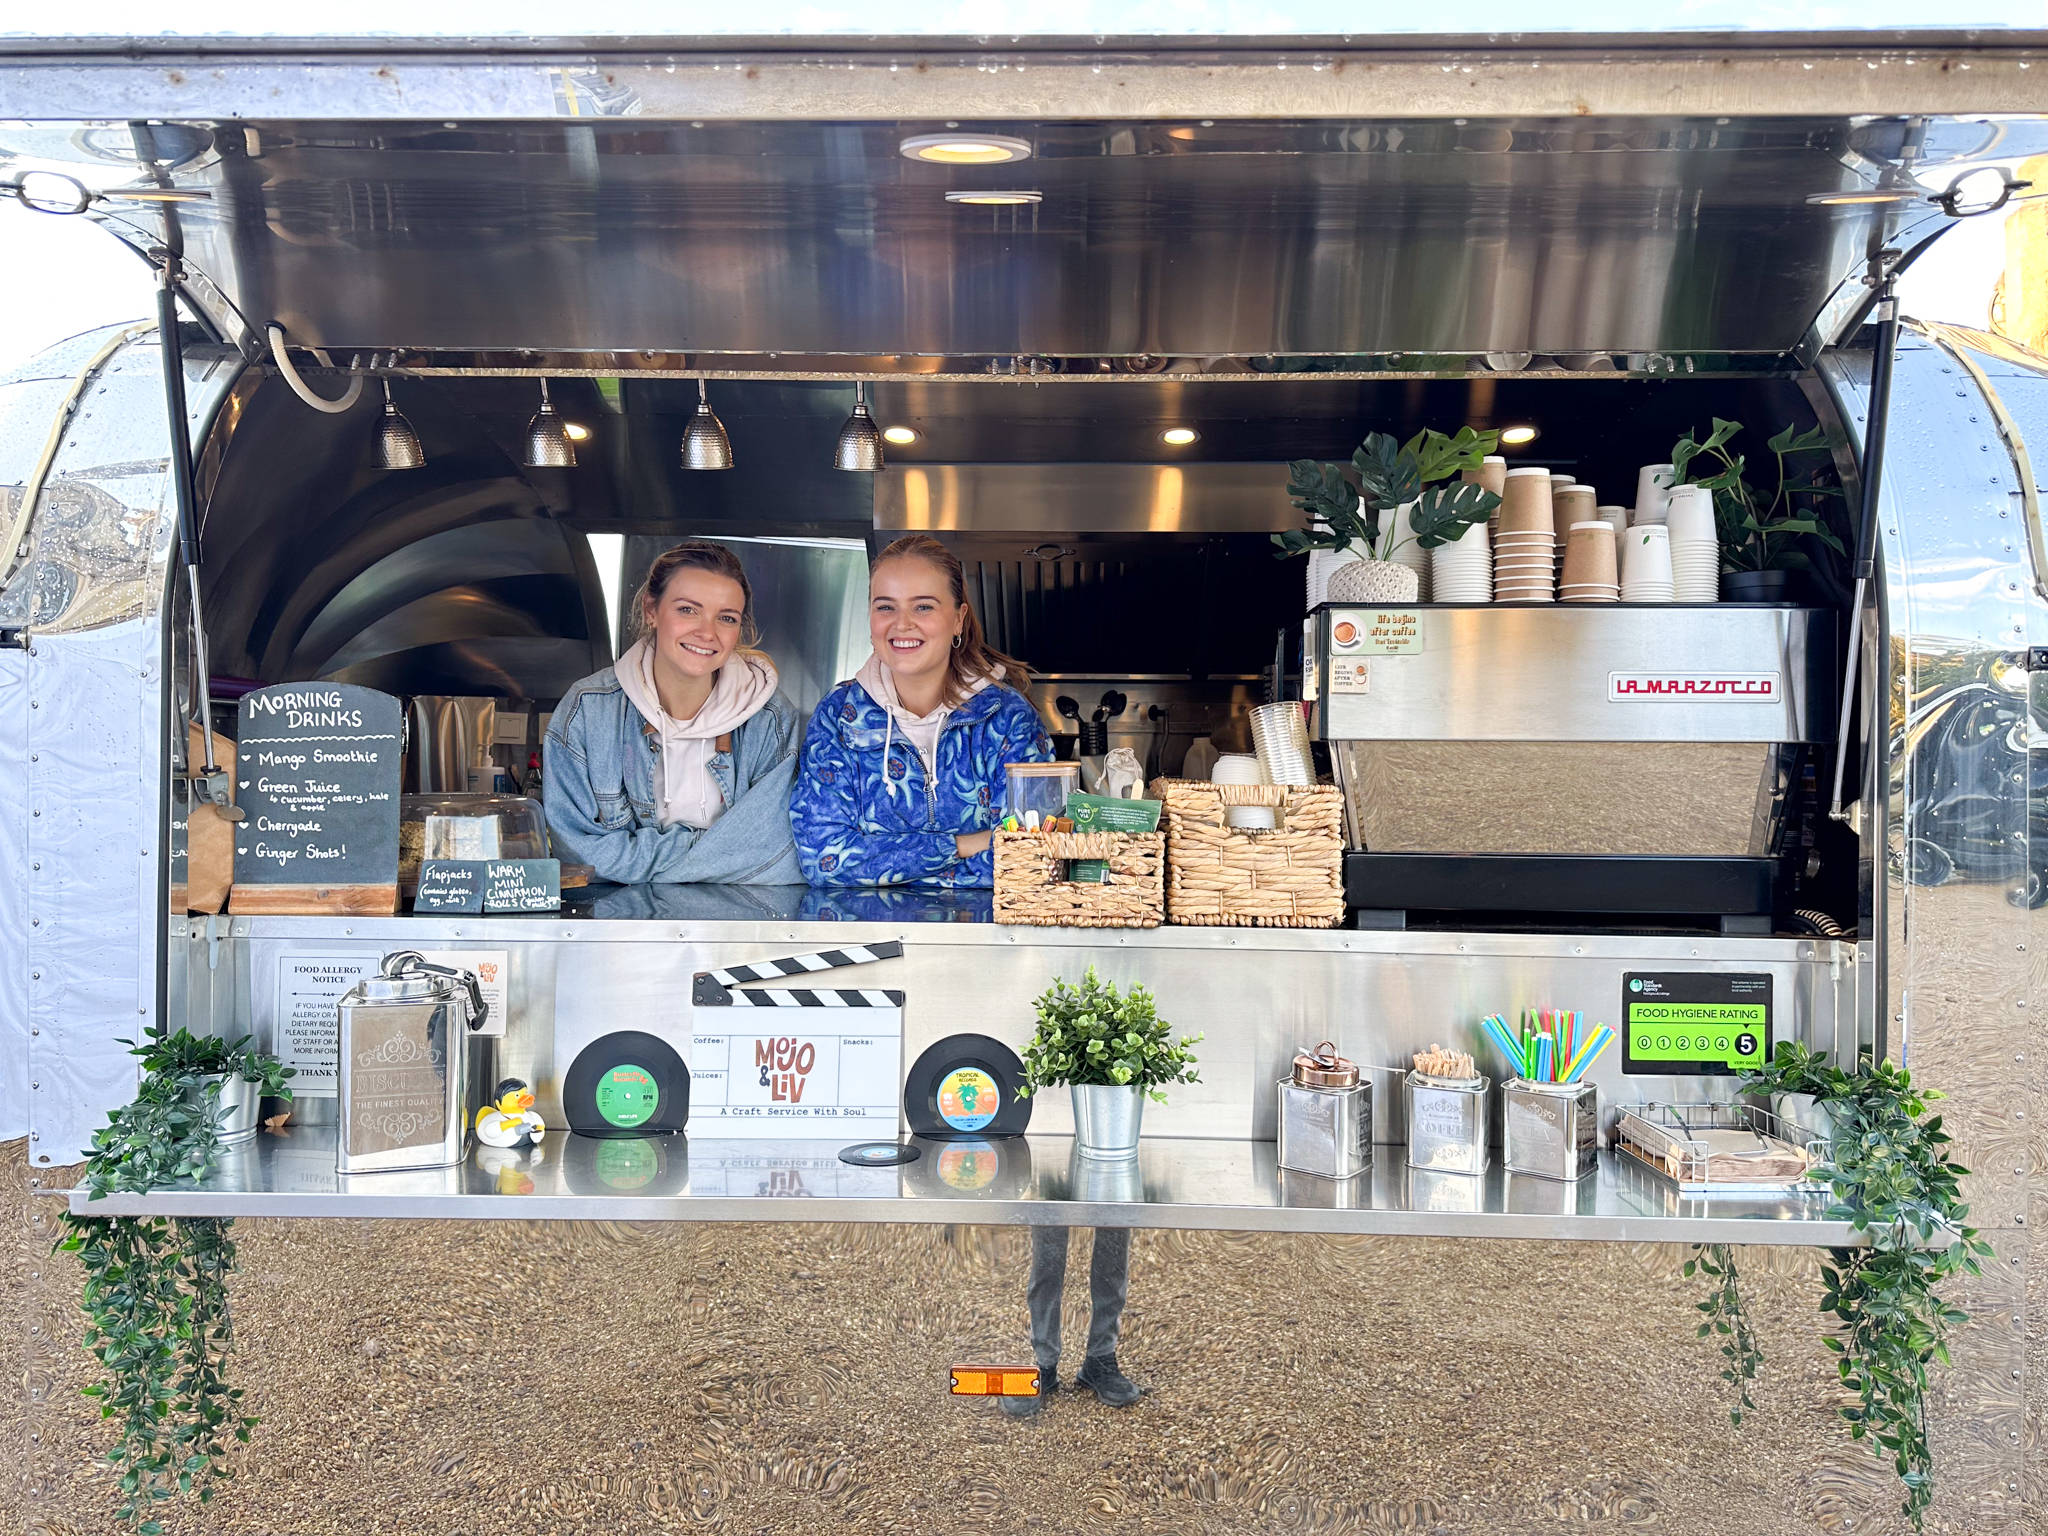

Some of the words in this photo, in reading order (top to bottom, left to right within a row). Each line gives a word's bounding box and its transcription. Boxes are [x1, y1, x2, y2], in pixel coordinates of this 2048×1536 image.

[1392, 614, 1416, 625] begins
[1370, 627, 1389, 636] after
[1392, 627, 1416, 636] coffee
[1617, 680, 1637, 694] LA
[250, 691, 342, 719] MORNING
[286, 710, 362, 729] DRINKS
[259, 752, 306, 770] Mango
[313, 749, 378, 763] Smoothie
[258, 777, 298, 793] Green
[305, 780, 341, 792] Juice
[258, 816, 322, 838] Cherryade
[256, 842, 298, 866] Ginger
[306, 844, 346, 859] Shots!
[426, 865, 472, 884] Flapjacks
[488, 864, 526, 878] WARM
[494, 876, 524, 890] MINI
[487, 885, 546, 899] CINNAMON
[321, 966, 362, 974] ALLERGY
[1637, 1009, 1669, 1018] FOOD
[1672, 1009, 1717, 1018] HYGIENE
[1720, 1010, 1758, 1019] RATING
[1641, 1039, 1648, 1047] 0
[1661, 1039, 1666, 1047] 1
[1680, 1039, 1686, 1047] 2
[1699, 1039, 1705, 1048] 3
[1718, 1039, 1724, 1048] 4
[1740, 1036, 1752, 1053] 5
[759, 1065, 770, 1086] &
[376, 1099, 404, 1108] FINEST
[408, 1097, 443, 1106] QUALITY
